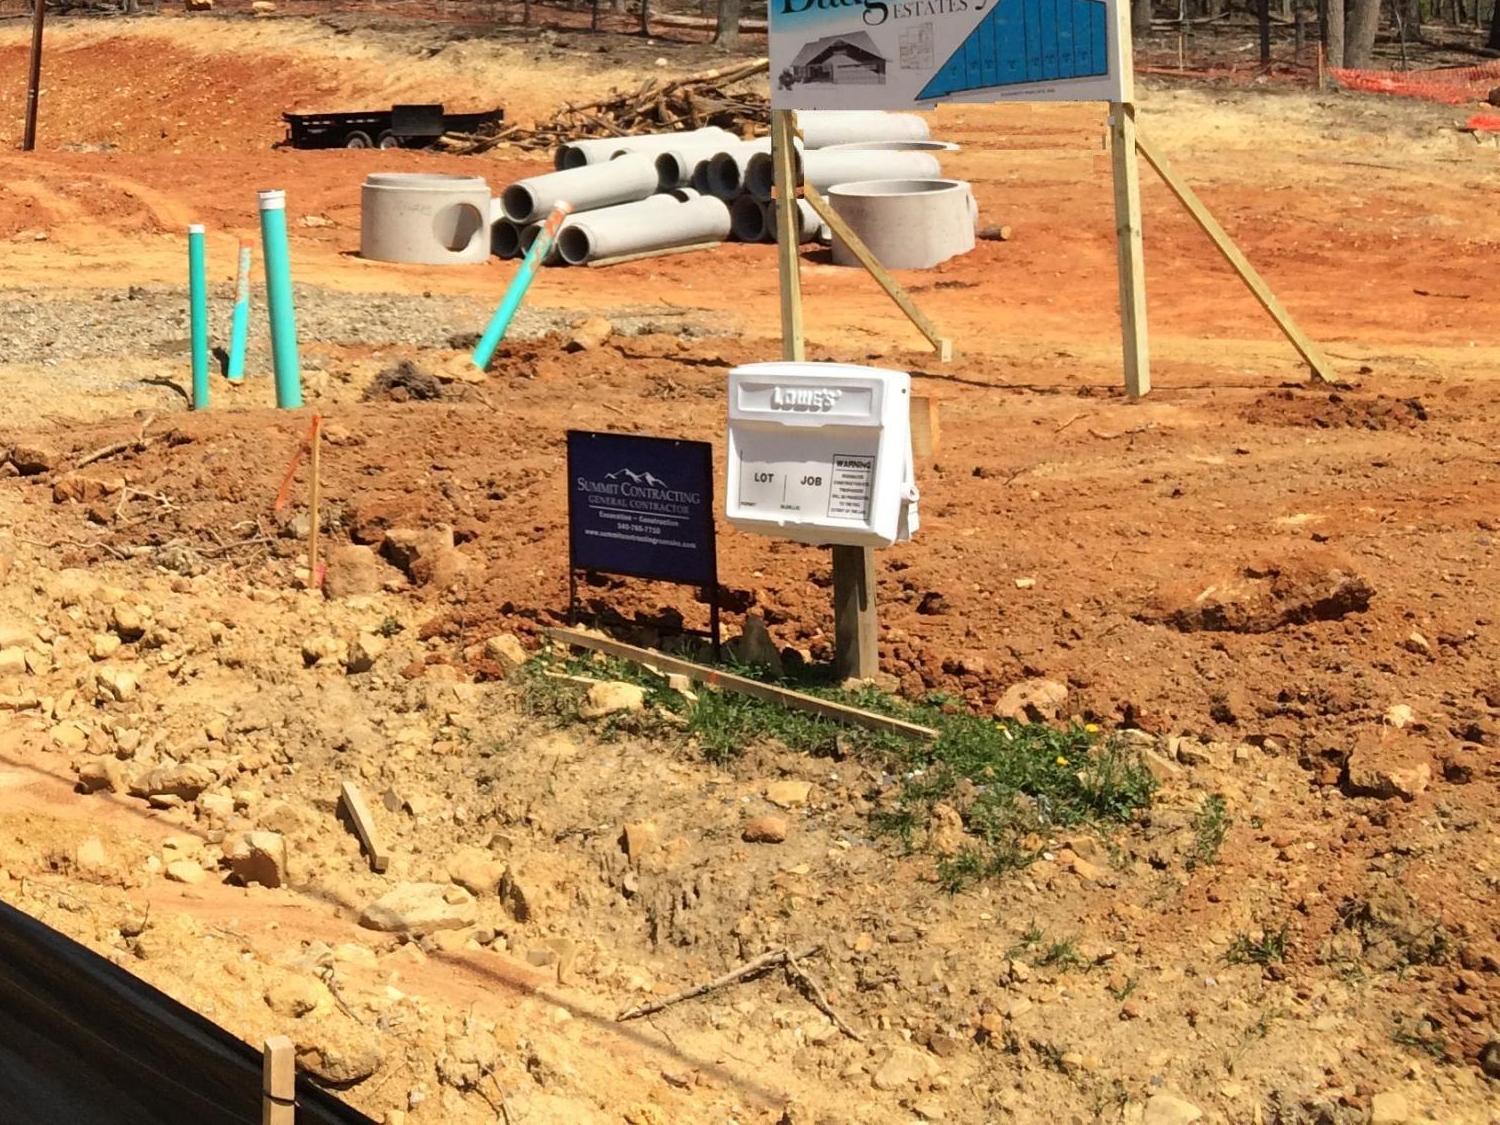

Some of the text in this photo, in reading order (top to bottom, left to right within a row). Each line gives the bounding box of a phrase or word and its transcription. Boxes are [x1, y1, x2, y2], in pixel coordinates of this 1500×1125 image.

[836, 459, 871, 469] WARNING
[754, 473, 774, 483] LOT
[800, 475, 822, 486] JOB
[577, 477, 700, 505] SUMMIT CONTRACTING
[588, 495, 689, 514] GENERAL CONTRACTOR
[638, 515, 679, 527] Construction
